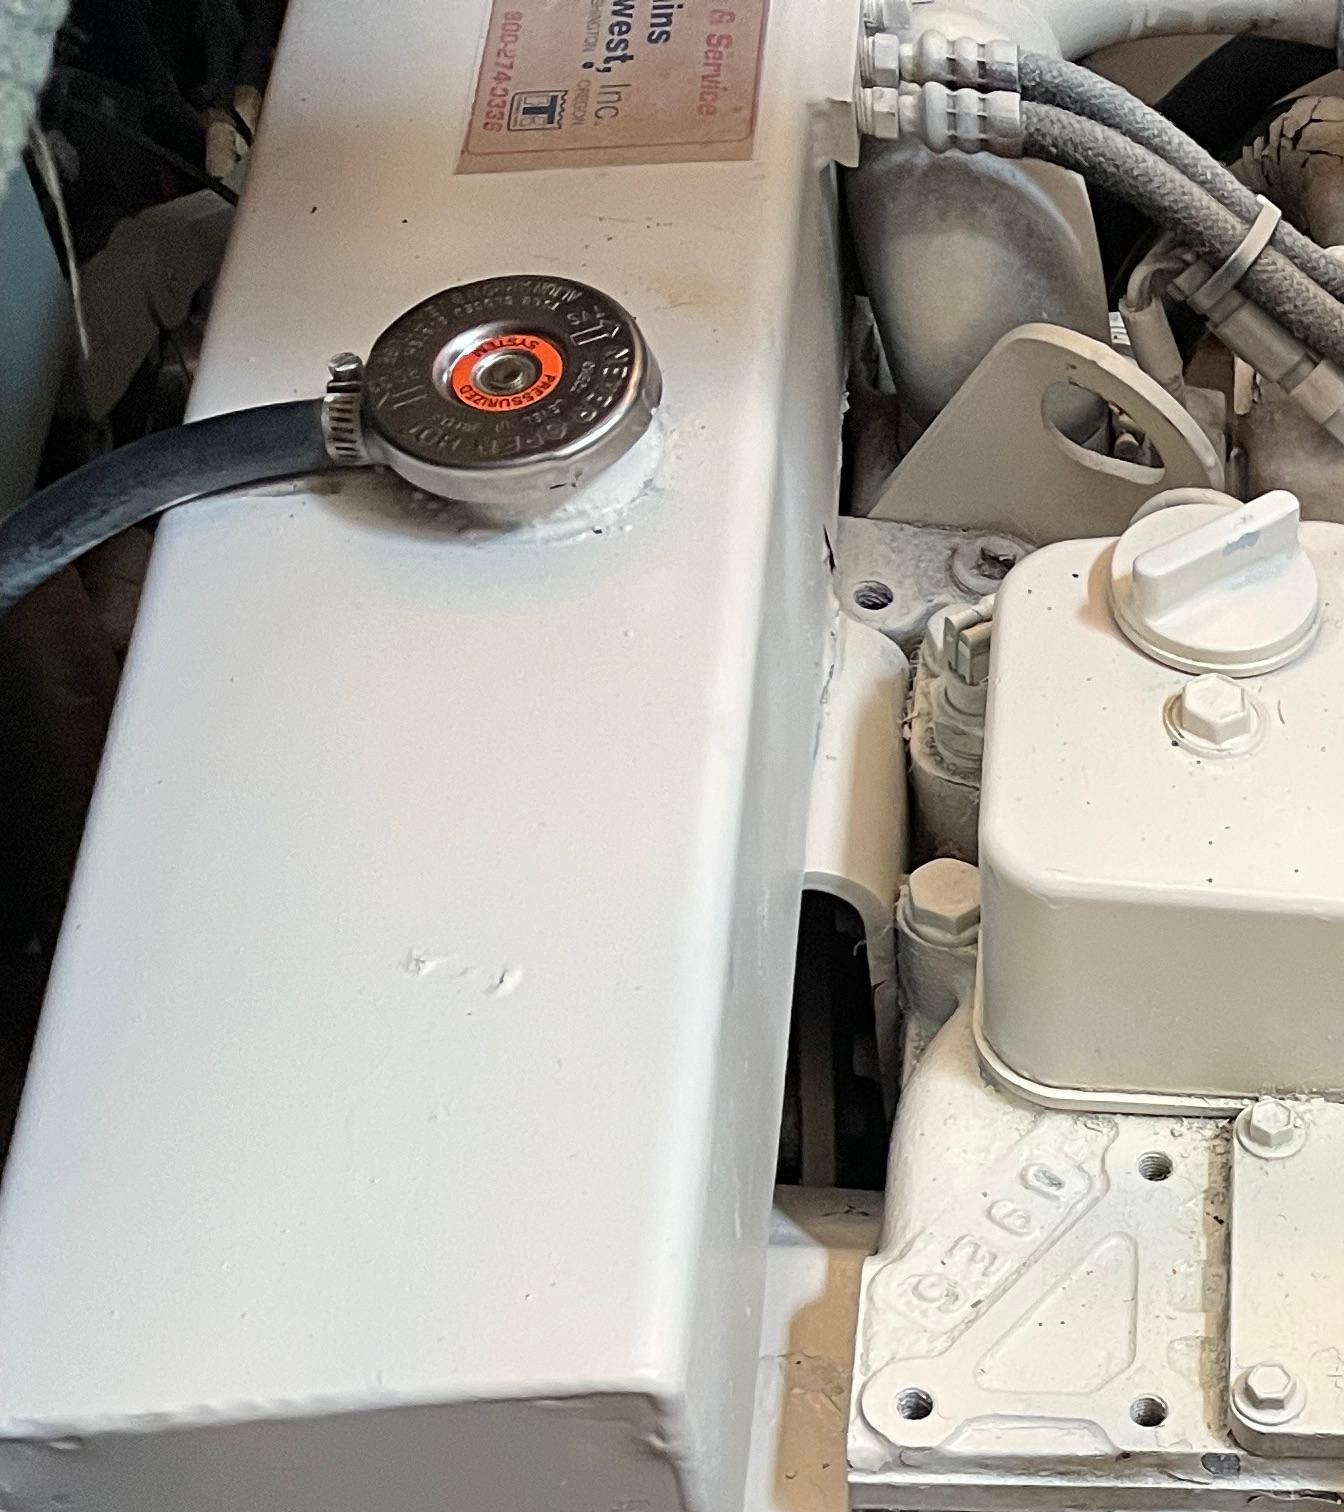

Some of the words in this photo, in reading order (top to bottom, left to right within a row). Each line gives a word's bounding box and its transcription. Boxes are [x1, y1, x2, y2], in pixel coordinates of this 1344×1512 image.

[646, 0, 684, 45] ins
[698, 32, 735, 118] Service
[594, 83, 632, 127] Inc.
[473, 338, 540, 358] SYSTEM
[458, 373, 558, 411] PRESSURIZED
